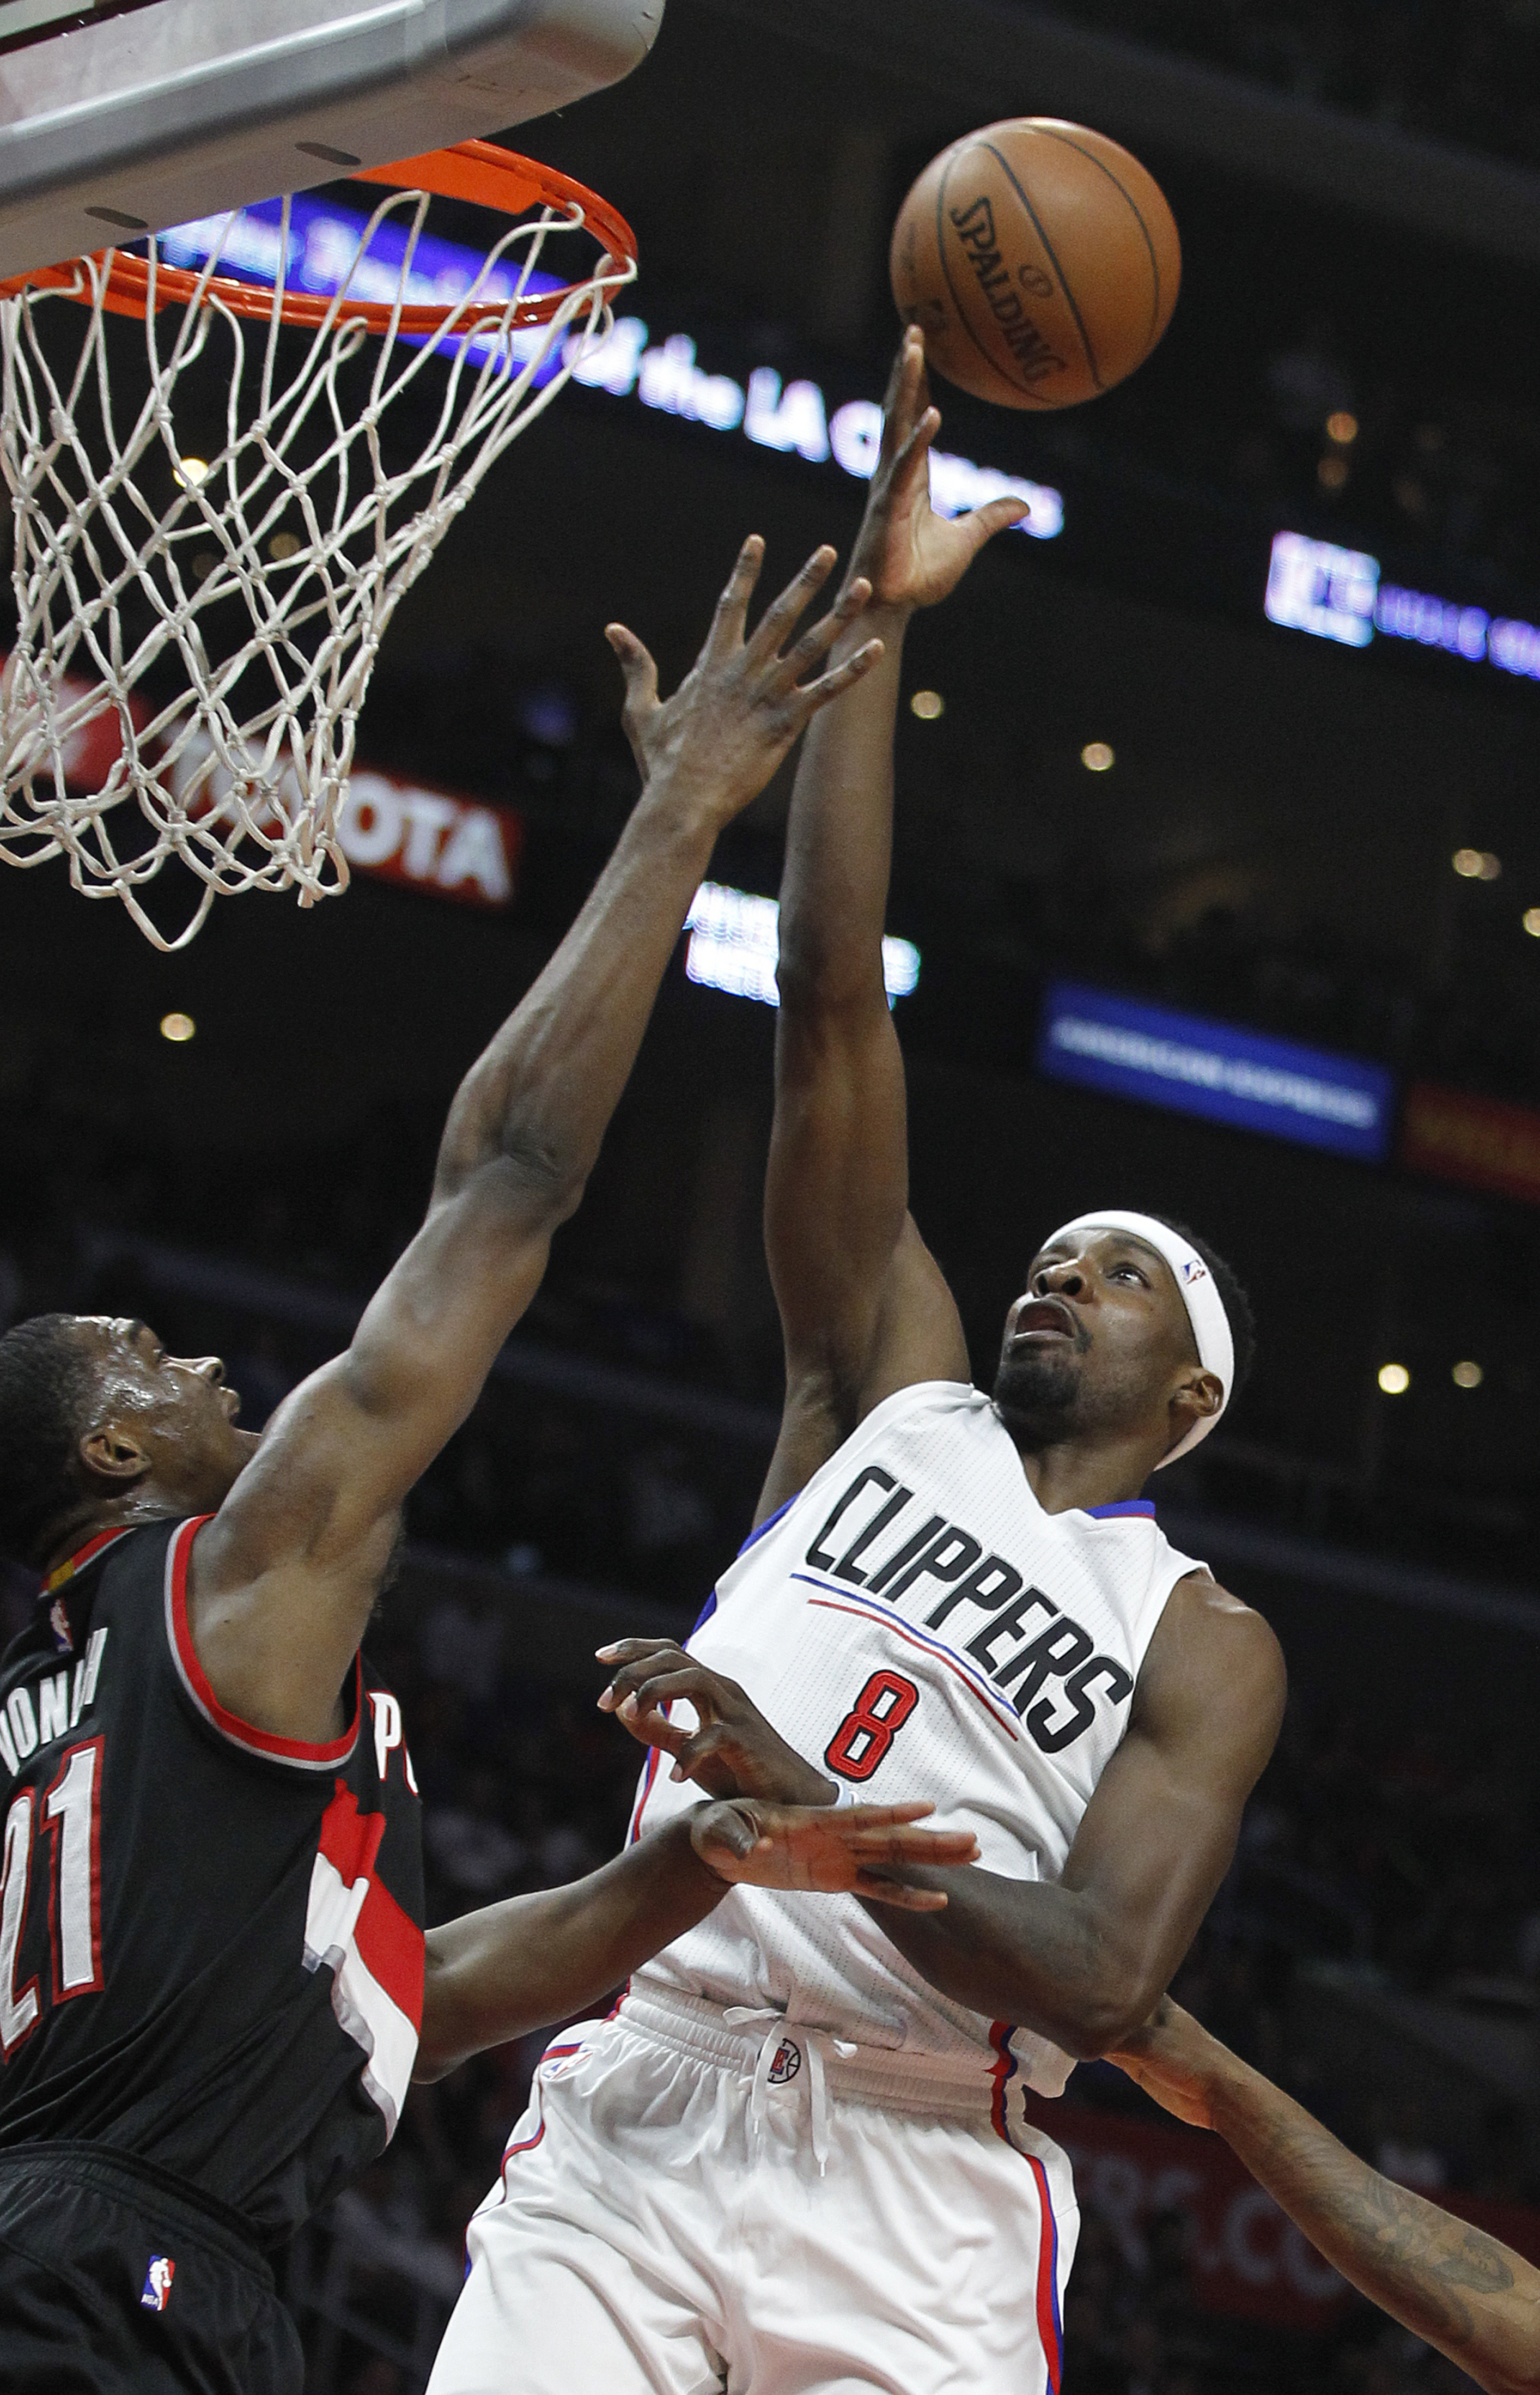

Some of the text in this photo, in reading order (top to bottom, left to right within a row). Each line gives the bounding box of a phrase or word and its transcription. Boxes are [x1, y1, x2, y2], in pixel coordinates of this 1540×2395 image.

[949, 196, 1069, 381] SPALDING
[744, 366, 831, 463] LA
[805, 1466, 1134, 1753] CLIPPERS
[824, 1669, 920, 1783] 8
[0, 1735, 105, 2064] 21
